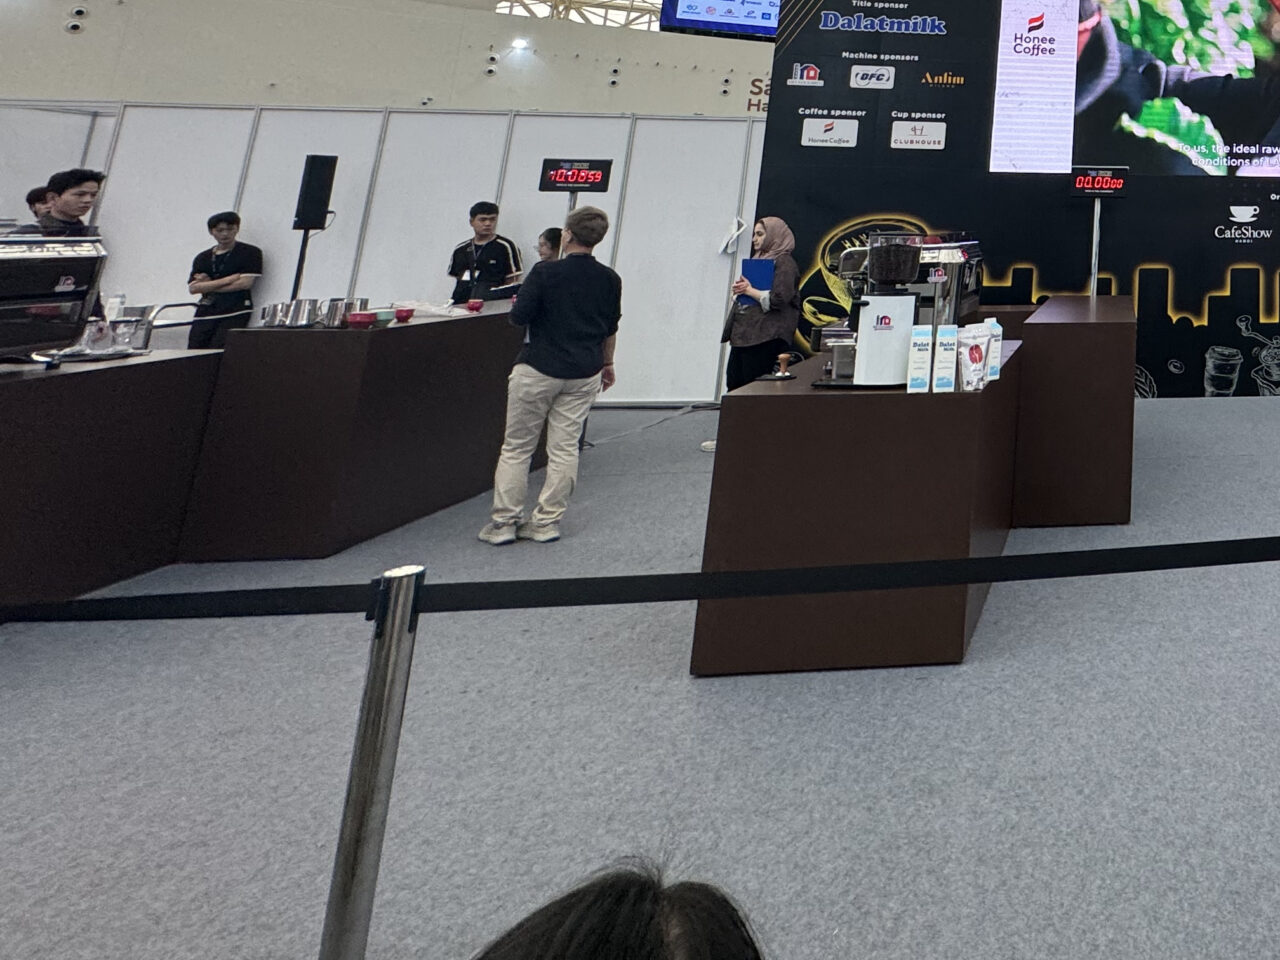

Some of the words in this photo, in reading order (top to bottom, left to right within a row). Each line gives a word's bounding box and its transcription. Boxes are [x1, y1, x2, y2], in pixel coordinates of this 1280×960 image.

[874, 0, 909, 9] sponsor
[820, 10, 947, 35] Dalatmilk
[1014, 33, 1056, 44] Honee
[1014, 43, 1056, 56] Coffee
[842, 51, 878, 60] Machine
[880, 52, 919, 62] sponsors
[798, 107, 828, 116] Coffee
[830, 108, 867, 117] sponsor
[892, 110, 909, 119] Cup
[911, 112, 946, 120] sponsor
[1179, 144, 1191, 152] To
[1193, 144, 1209, 154] us,
[1212, 144, 1230, 153] the
[1233, 144, 1259, 154] ideal
[1192, 158, 1250, 167] conditions
[1252, 158, 1263, 167] of
[1214, 226, 1272, 238] CafeShow
